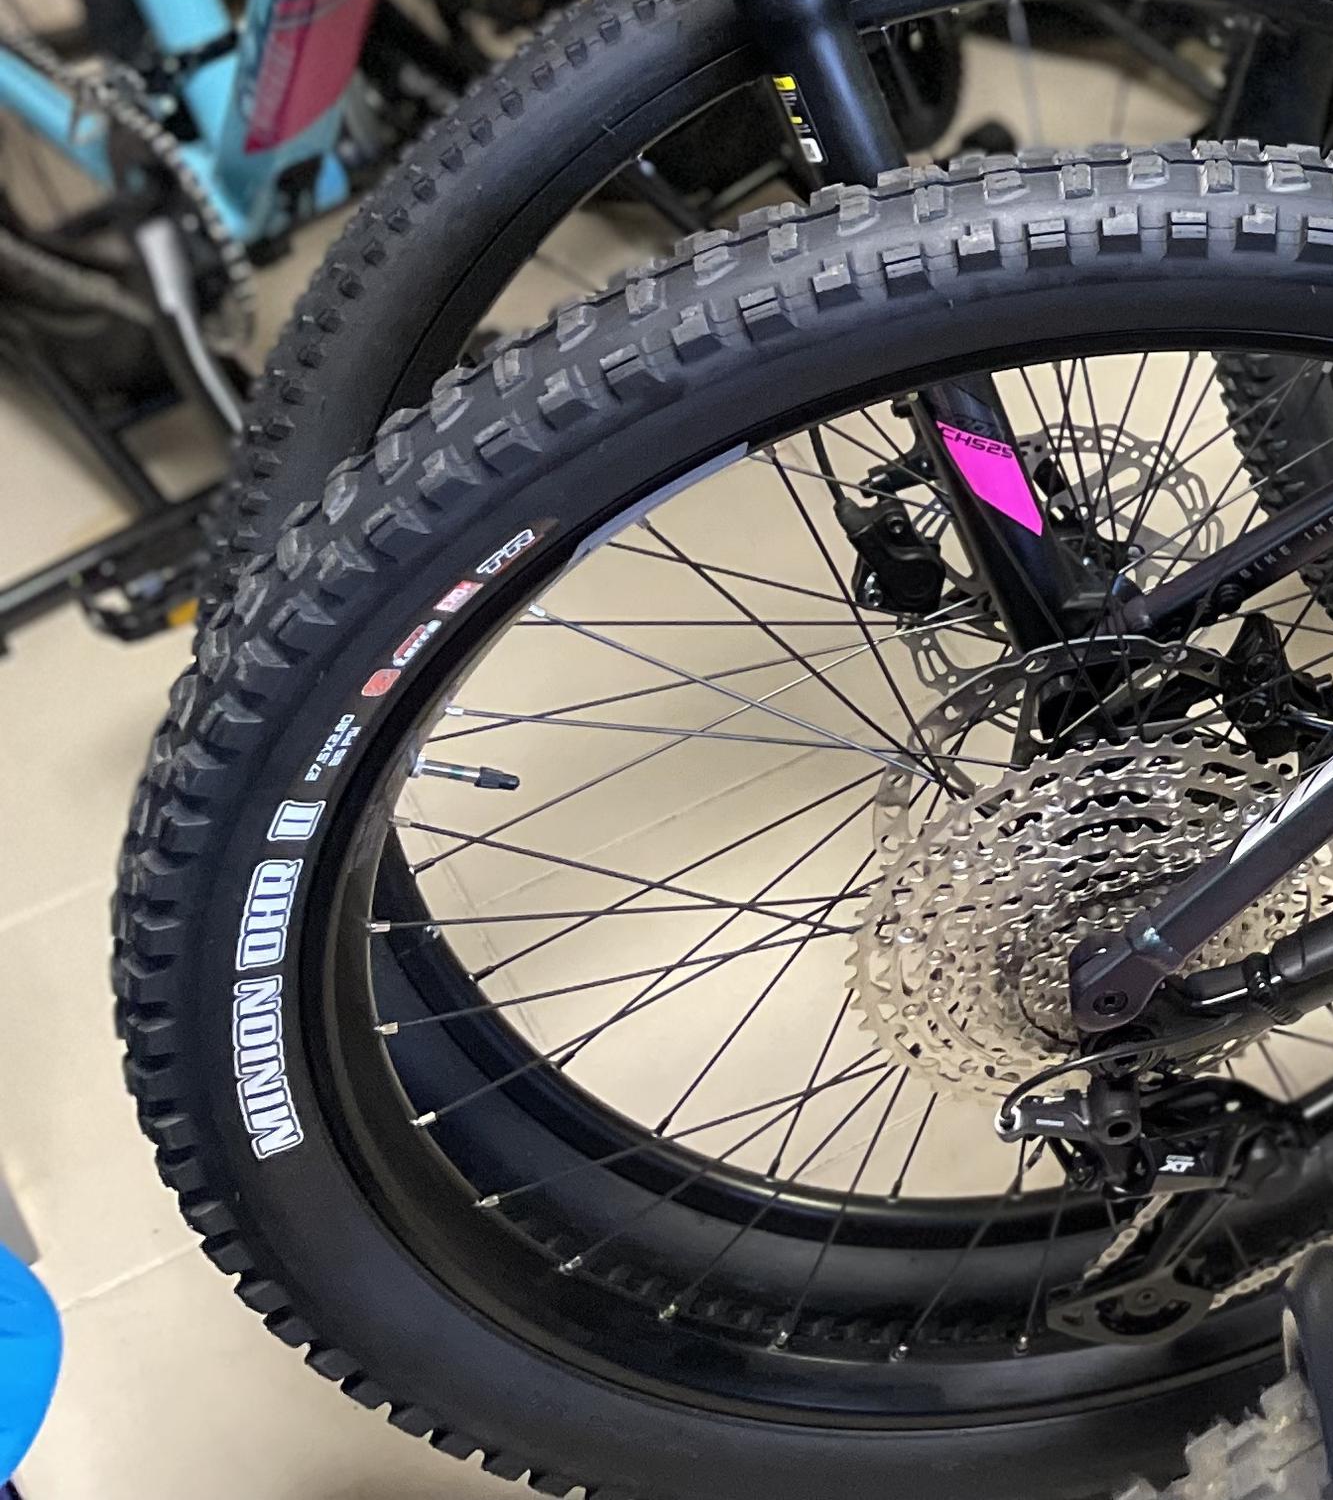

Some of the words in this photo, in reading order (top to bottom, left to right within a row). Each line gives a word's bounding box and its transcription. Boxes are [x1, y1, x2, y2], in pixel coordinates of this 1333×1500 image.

[476, 528, 536, 575] TR
[235, 858, 304, 971] DHR
[233, 974, 304, 1160] MINION
